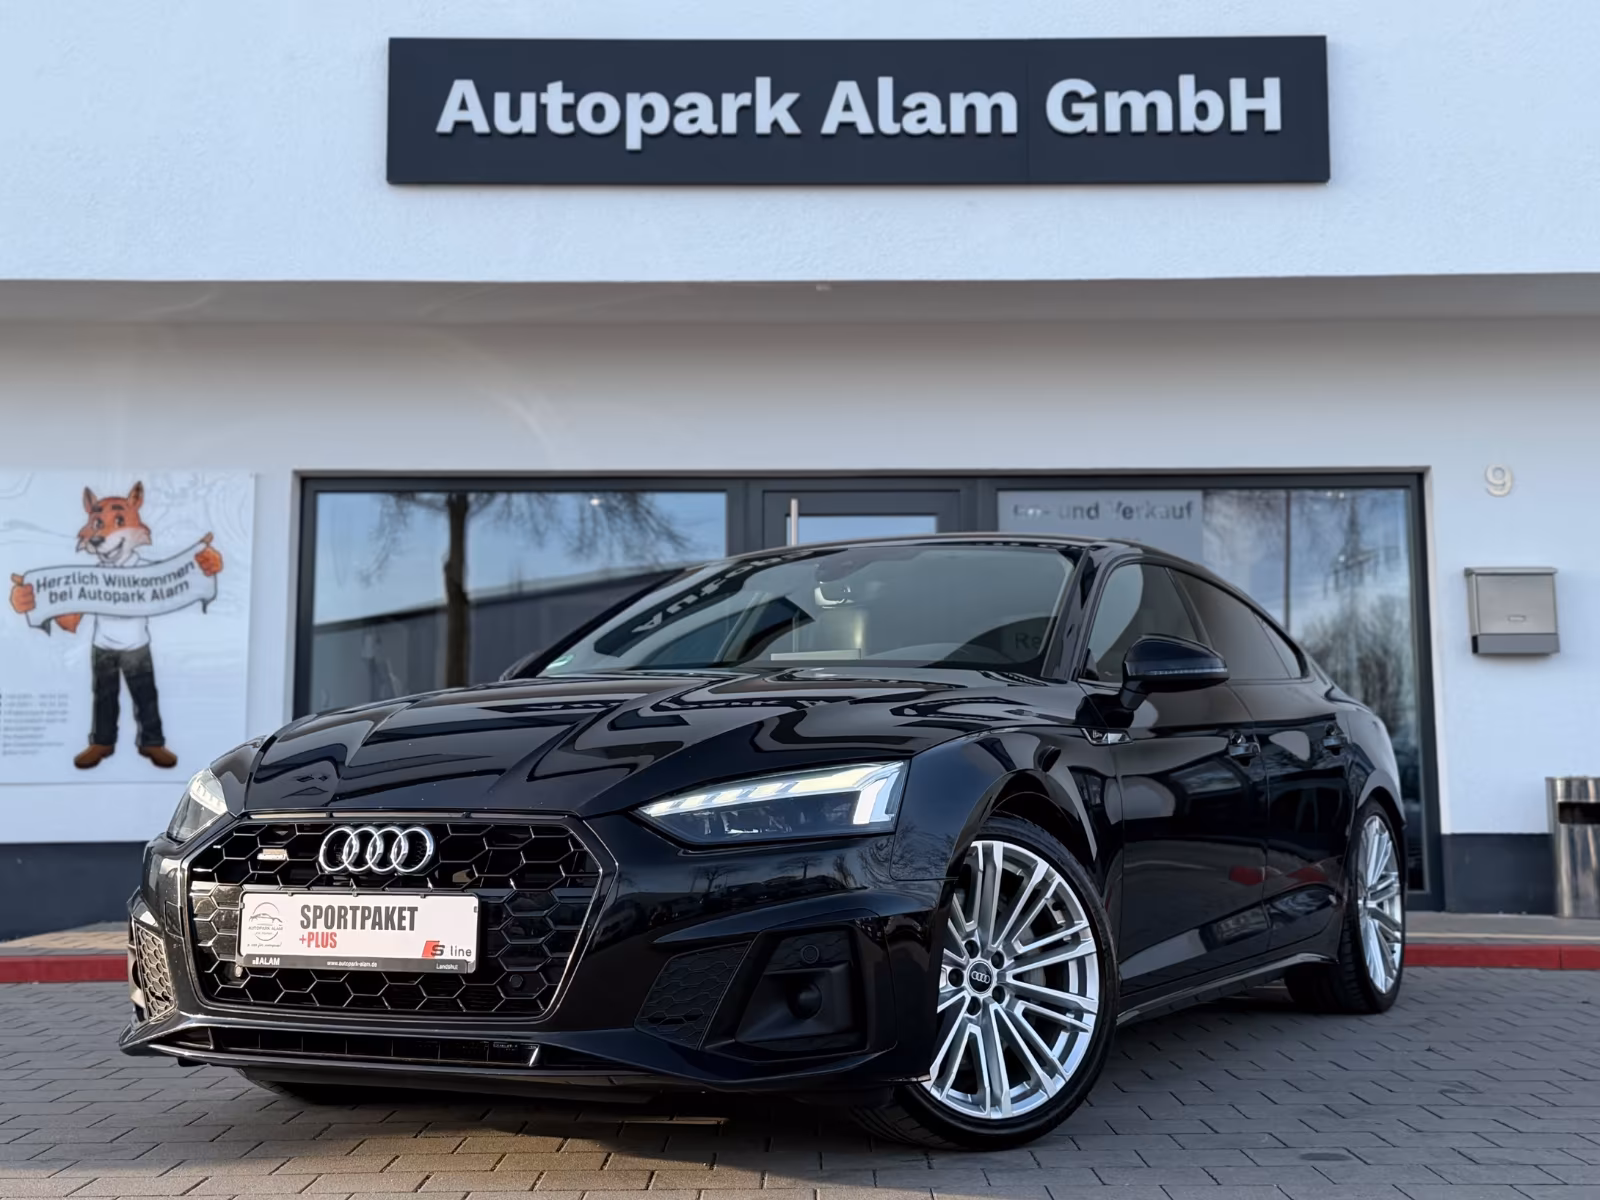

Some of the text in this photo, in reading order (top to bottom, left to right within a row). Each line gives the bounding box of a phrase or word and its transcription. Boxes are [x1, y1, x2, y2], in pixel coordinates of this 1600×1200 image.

[435, 73, 1283, 152] Autopark Alam GmbH
[1484, 462, 1514, 498] 9
[1057, 501, 1100, 521] und
[36, 560, 196, 594] Herzlich Willkommen
[49, 580, 190, 605] bei Autopark Alam
[299, 904, 419, 932] SPORTPAKET
[299, 931, 337, 949] +PLUS
[430, 944, 472, 957] S line
[259, 956, 281, 966] ALAM
